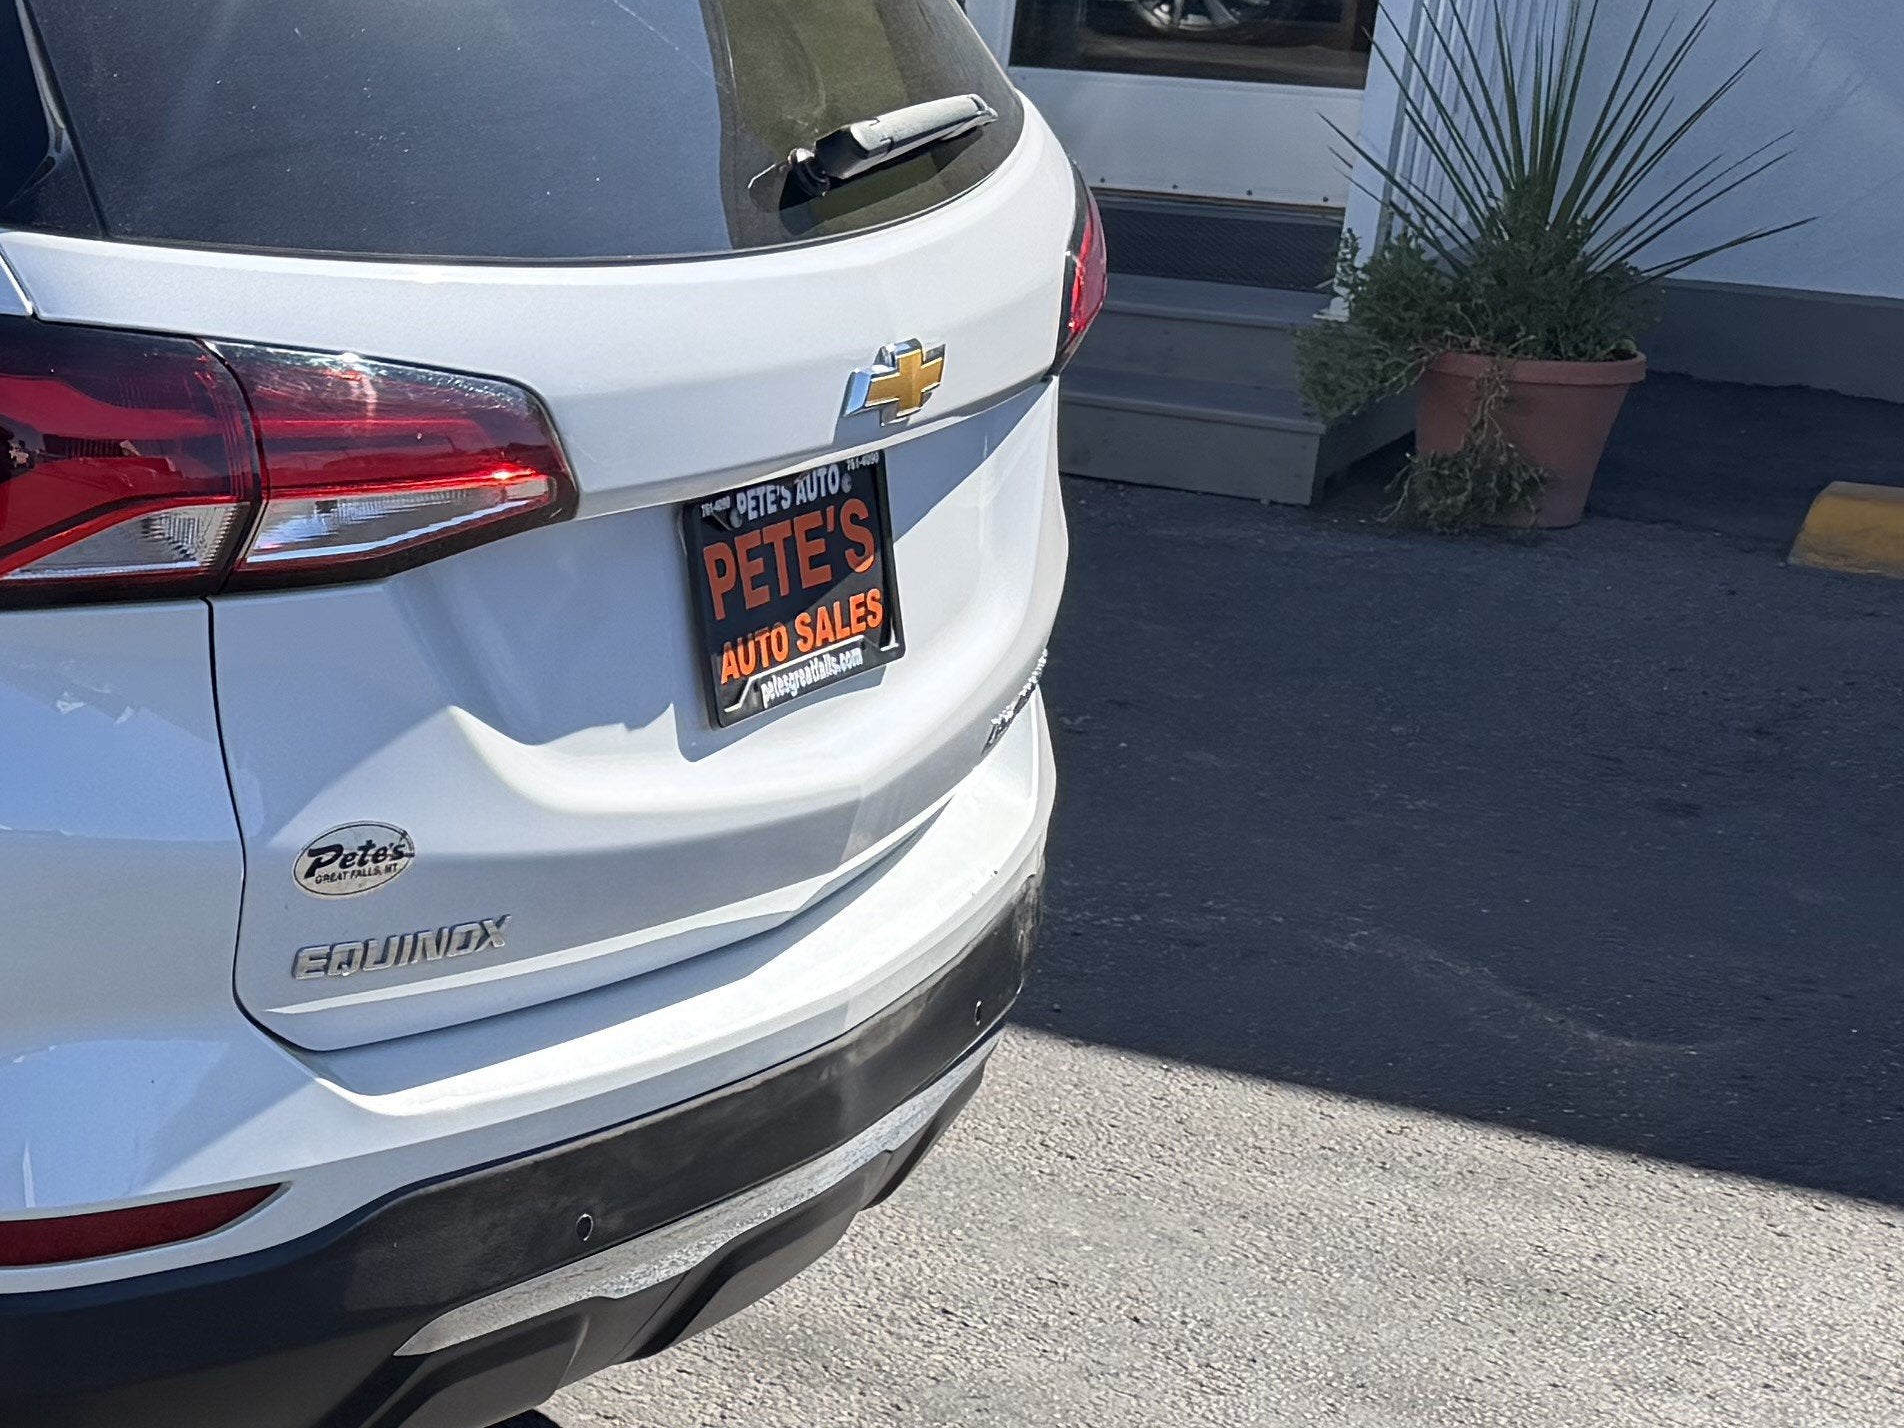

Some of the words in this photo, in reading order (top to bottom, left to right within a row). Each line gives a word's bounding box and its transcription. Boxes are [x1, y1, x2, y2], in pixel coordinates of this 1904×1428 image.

[736, 483, 792, 521] PETE'S
[794, 463, 841, 506] AUTO
[703, 498, 876, 620] PETE'S
[721, 622, 789, 685] AUTO
[794, 588, 884, 653] SALES
[304, 839, 406, 880] Pete's
[292, 914, 512, 980] EQUINOX
